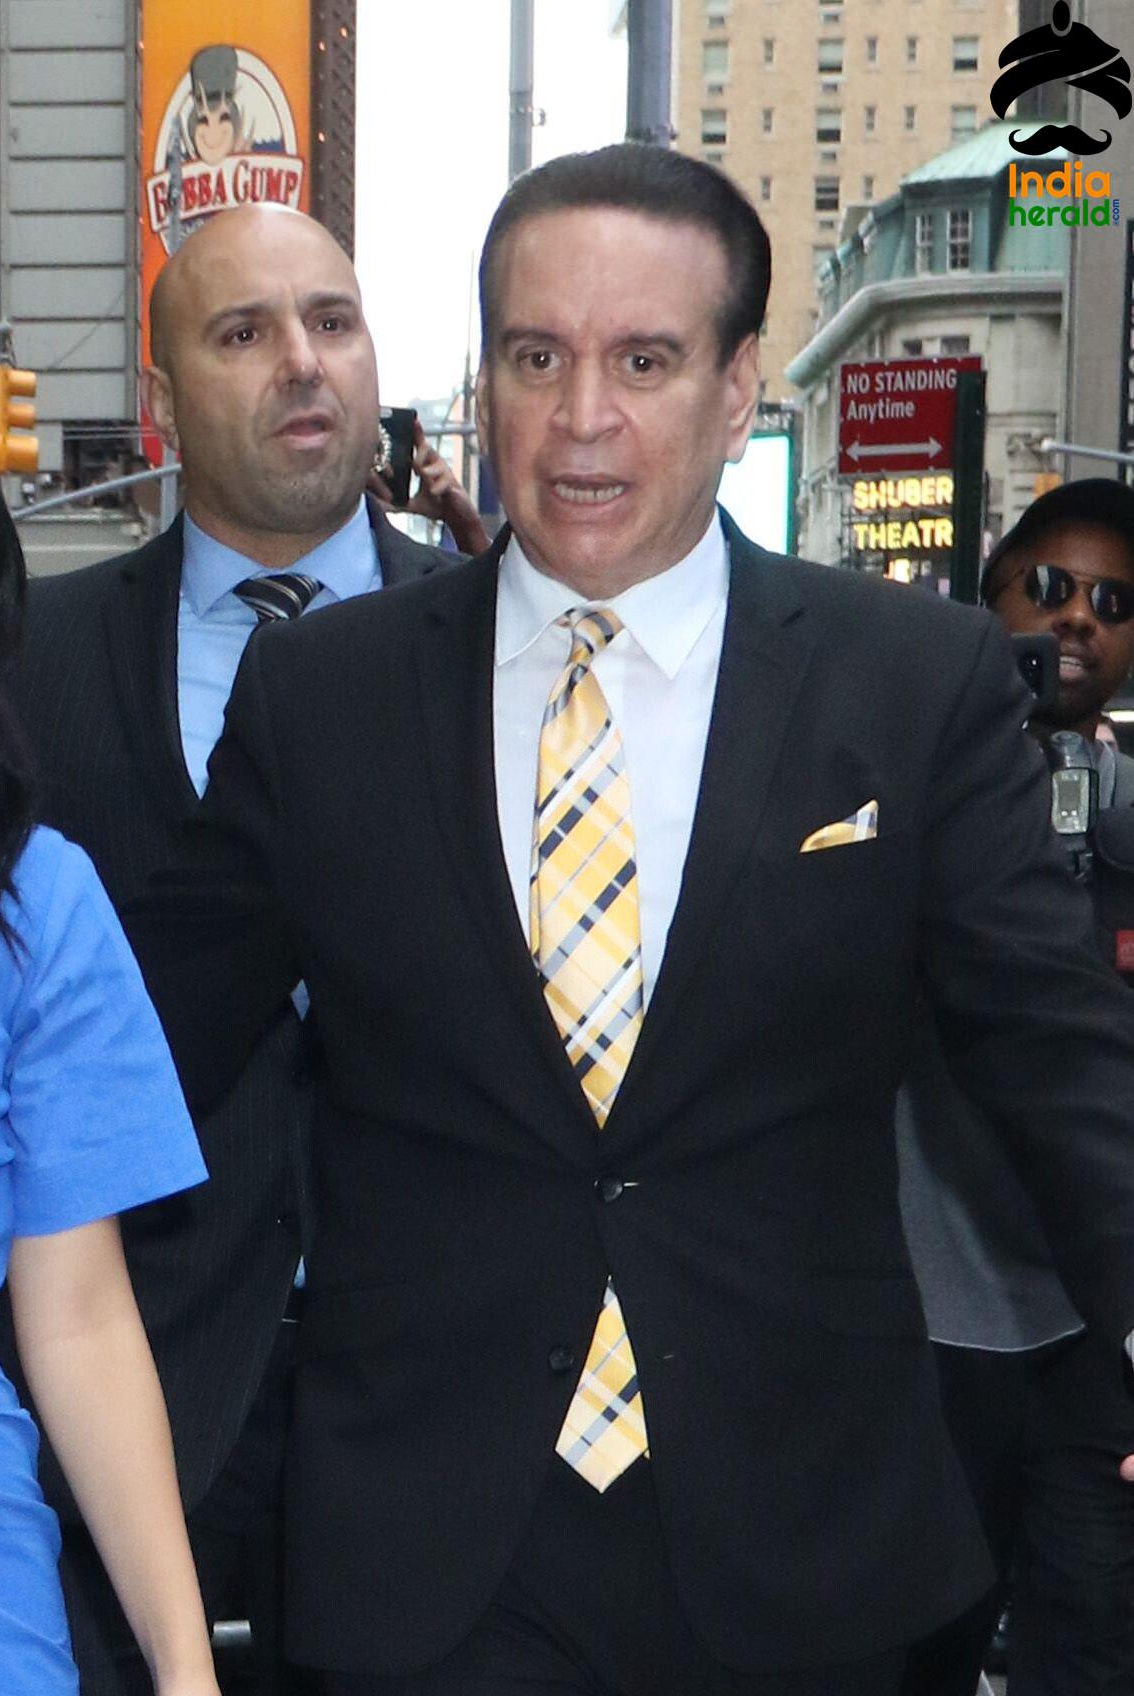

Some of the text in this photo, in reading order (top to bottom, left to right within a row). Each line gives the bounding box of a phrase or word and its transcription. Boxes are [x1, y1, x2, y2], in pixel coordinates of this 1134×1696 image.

[153, 159, 299, 223] BBBA GUMP
[846, 368, 958, 395] NO STANDING
[846, 399, 916, 424] Anytime
[853, 475, 954, 510] SHUBER
[853, 517, 954, 551] THEATR
